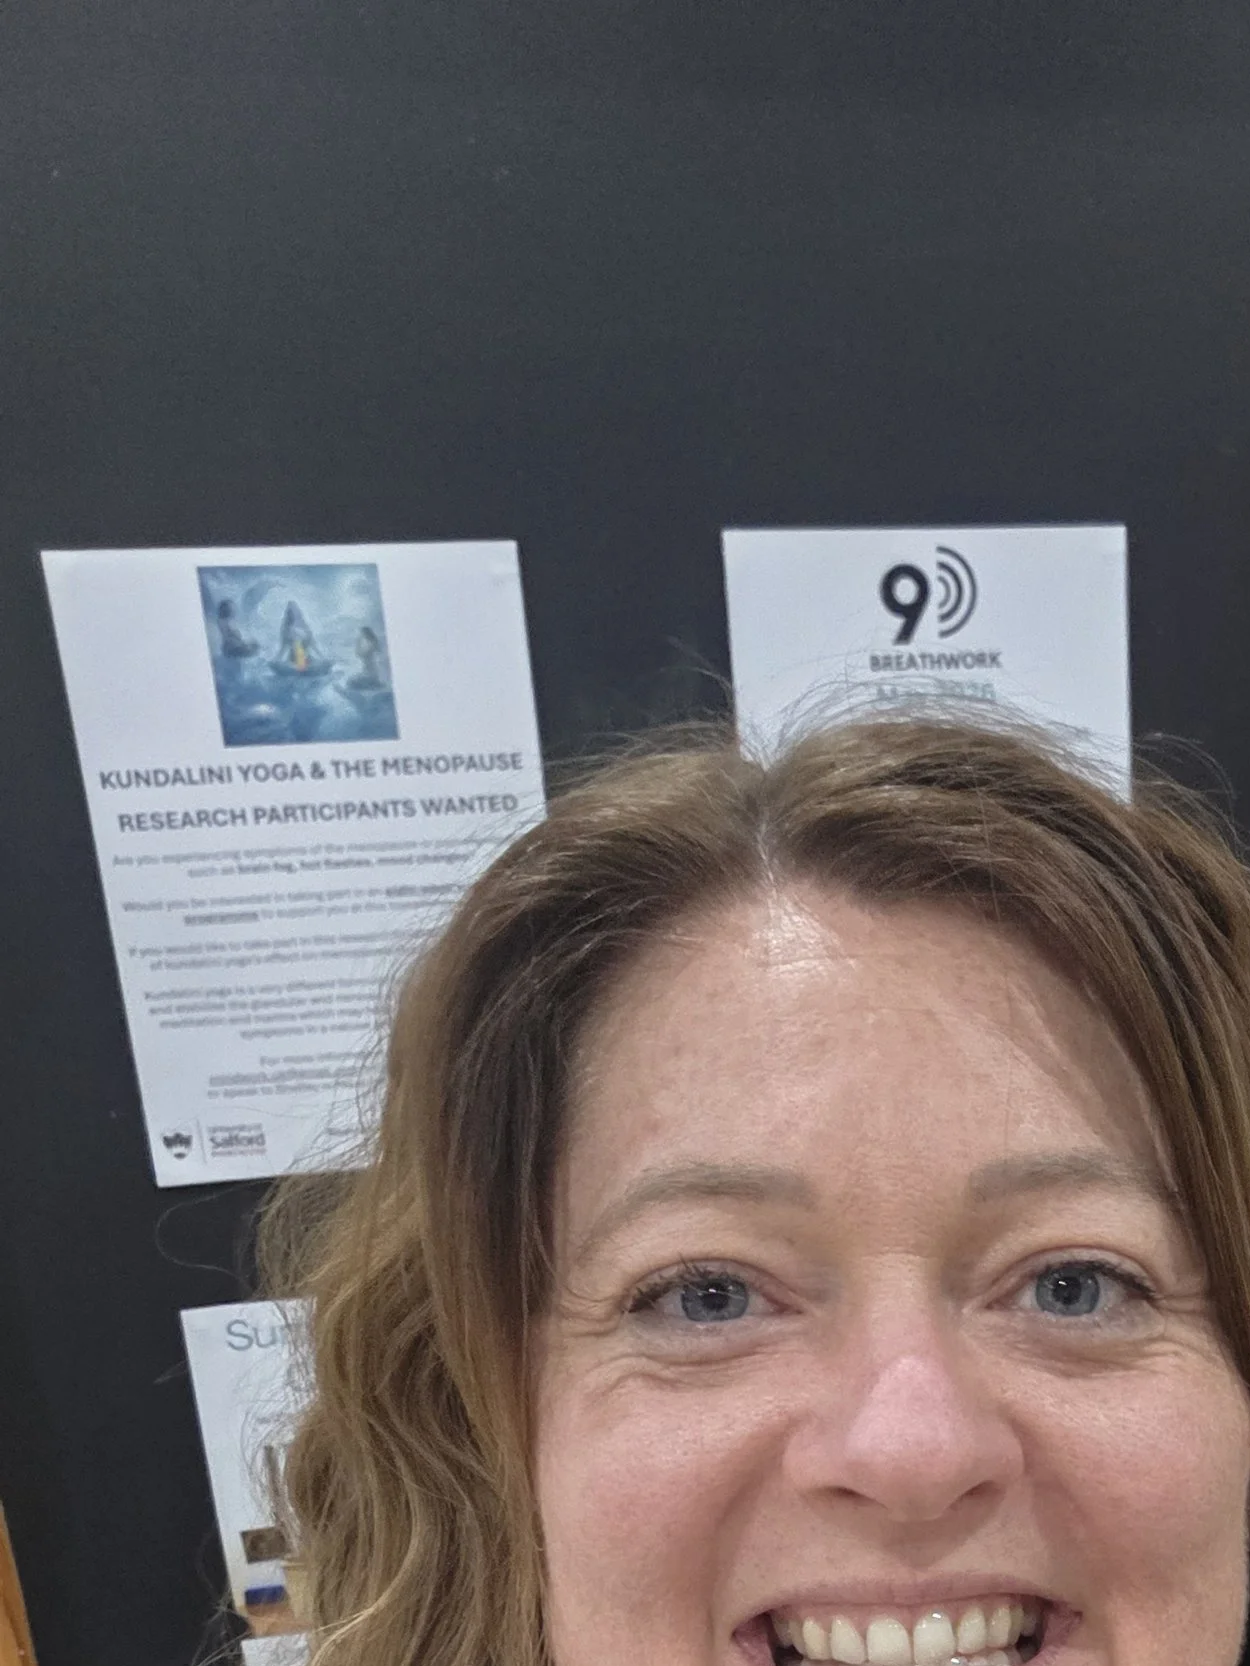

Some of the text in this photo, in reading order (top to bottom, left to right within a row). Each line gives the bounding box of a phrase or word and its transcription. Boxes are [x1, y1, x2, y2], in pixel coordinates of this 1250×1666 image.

[880, 563, 930, 646] 9
[870, 651, 1003, 671] BREATHWORK
[99, 752, 524, 790] KUNDALINI YOGA & THE MENOPAUSE
[117, 794, 519, 832] RESEARCH PARTICIPANTS WANTED
